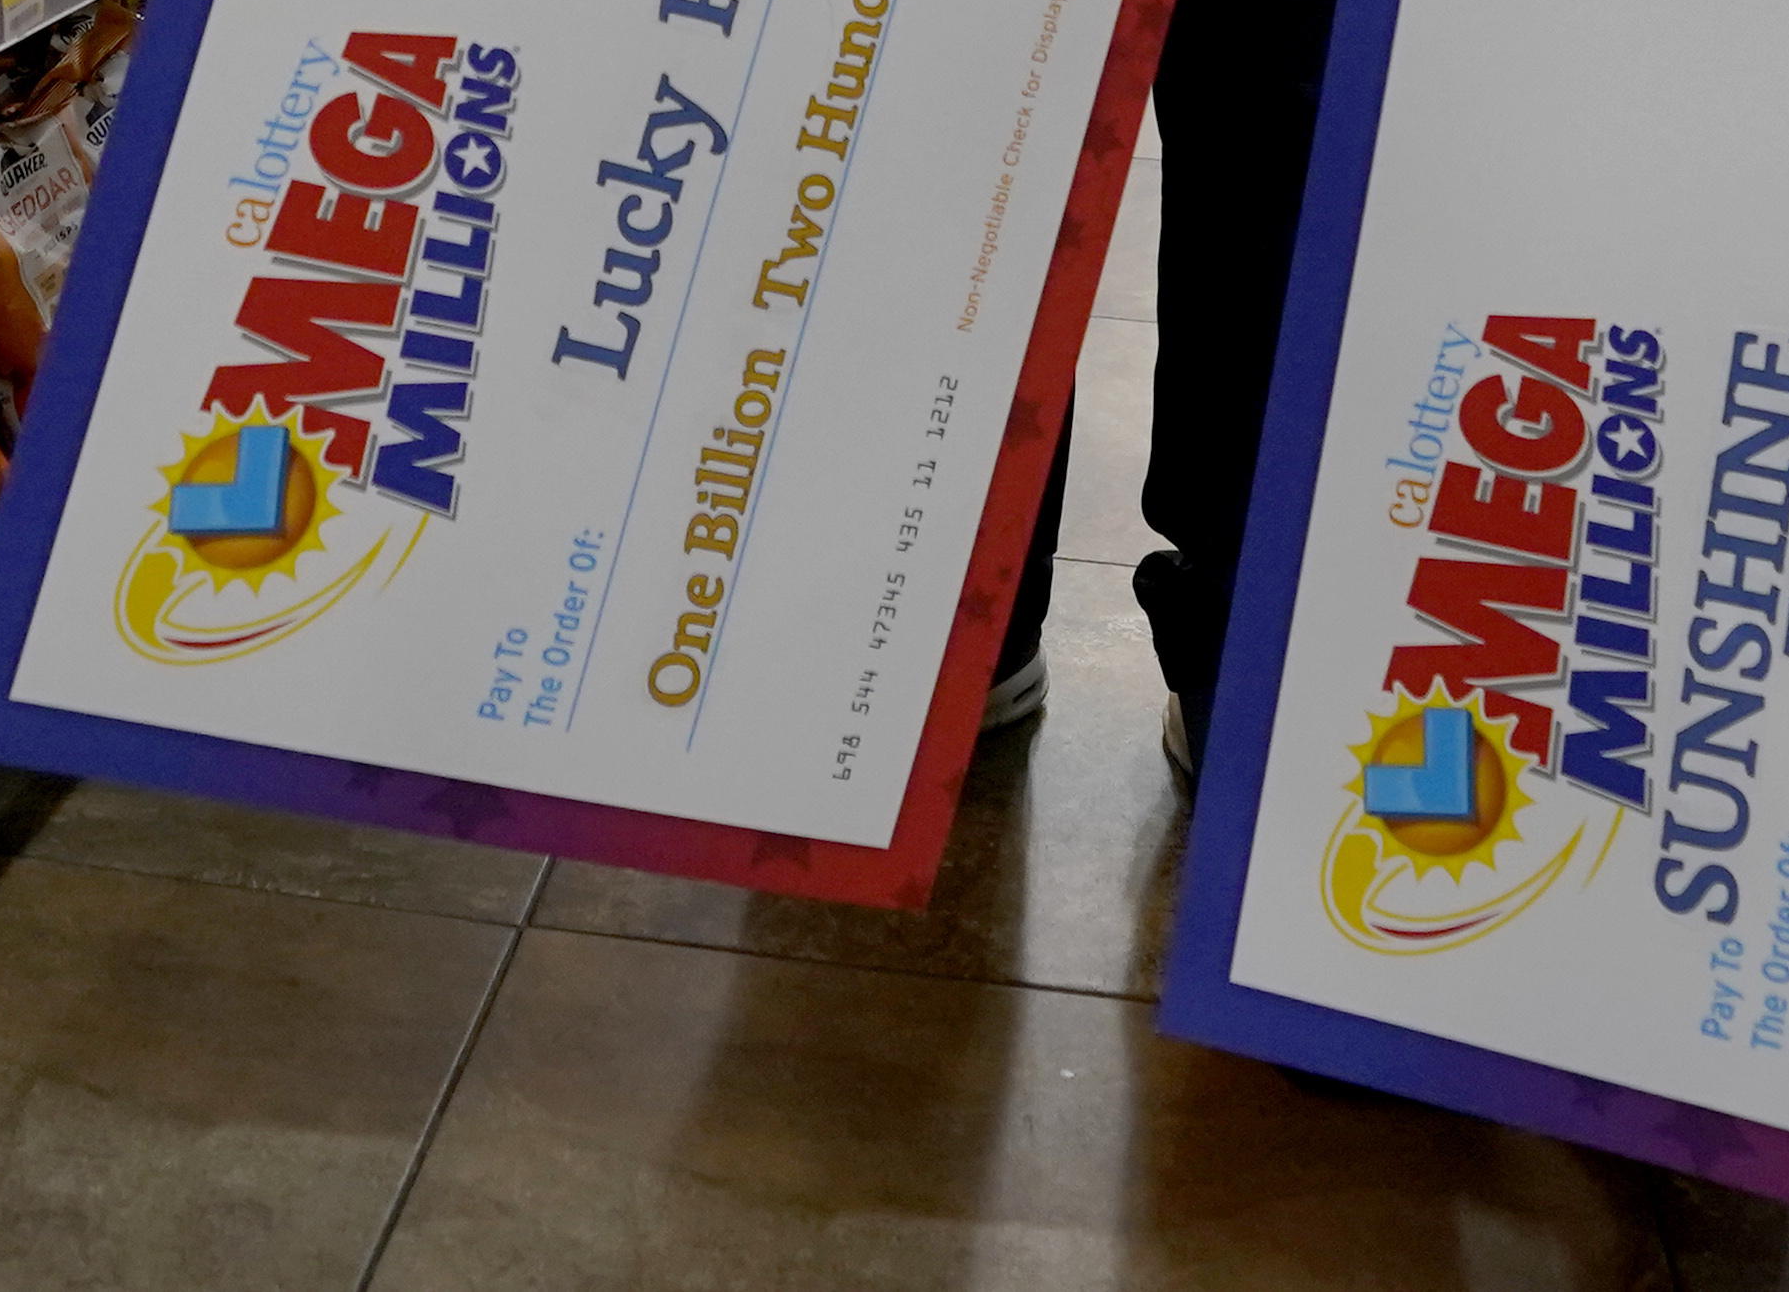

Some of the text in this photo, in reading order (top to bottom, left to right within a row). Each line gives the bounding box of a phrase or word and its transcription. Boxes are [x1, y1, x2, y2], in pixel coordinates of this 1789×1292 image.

[224, 39, 342, 248] calottery
[552, 73, 727, 380] Lucky
[752, 174, 836, 310] Two
[958, 171, 1015, 335] Non-Negotiable
[1002, 102, 1033, 168] Check
[1021, 69, 1042, 99] for
[199, 29, 460, 487] MEGA
[371, 42, 518, 518] MILLIONS
[683, 348, 787, 567] Billion
[1386, 323, 1485, 529] calottery
[523, 529, 604, 727] The Order Of:
[645, 581, 724, 708] One
[832, 375, 959, 782] 698 544 47345 435 11 1212
[1384, 314, 1598, 770] MEGA
[1560, 325, 1663, 810] MILLIONS
[477, 628, 528, 721] Pay To
[1701, 937, 1744, 1042] Pay To
[1750, 994, 1788, 1050] The
